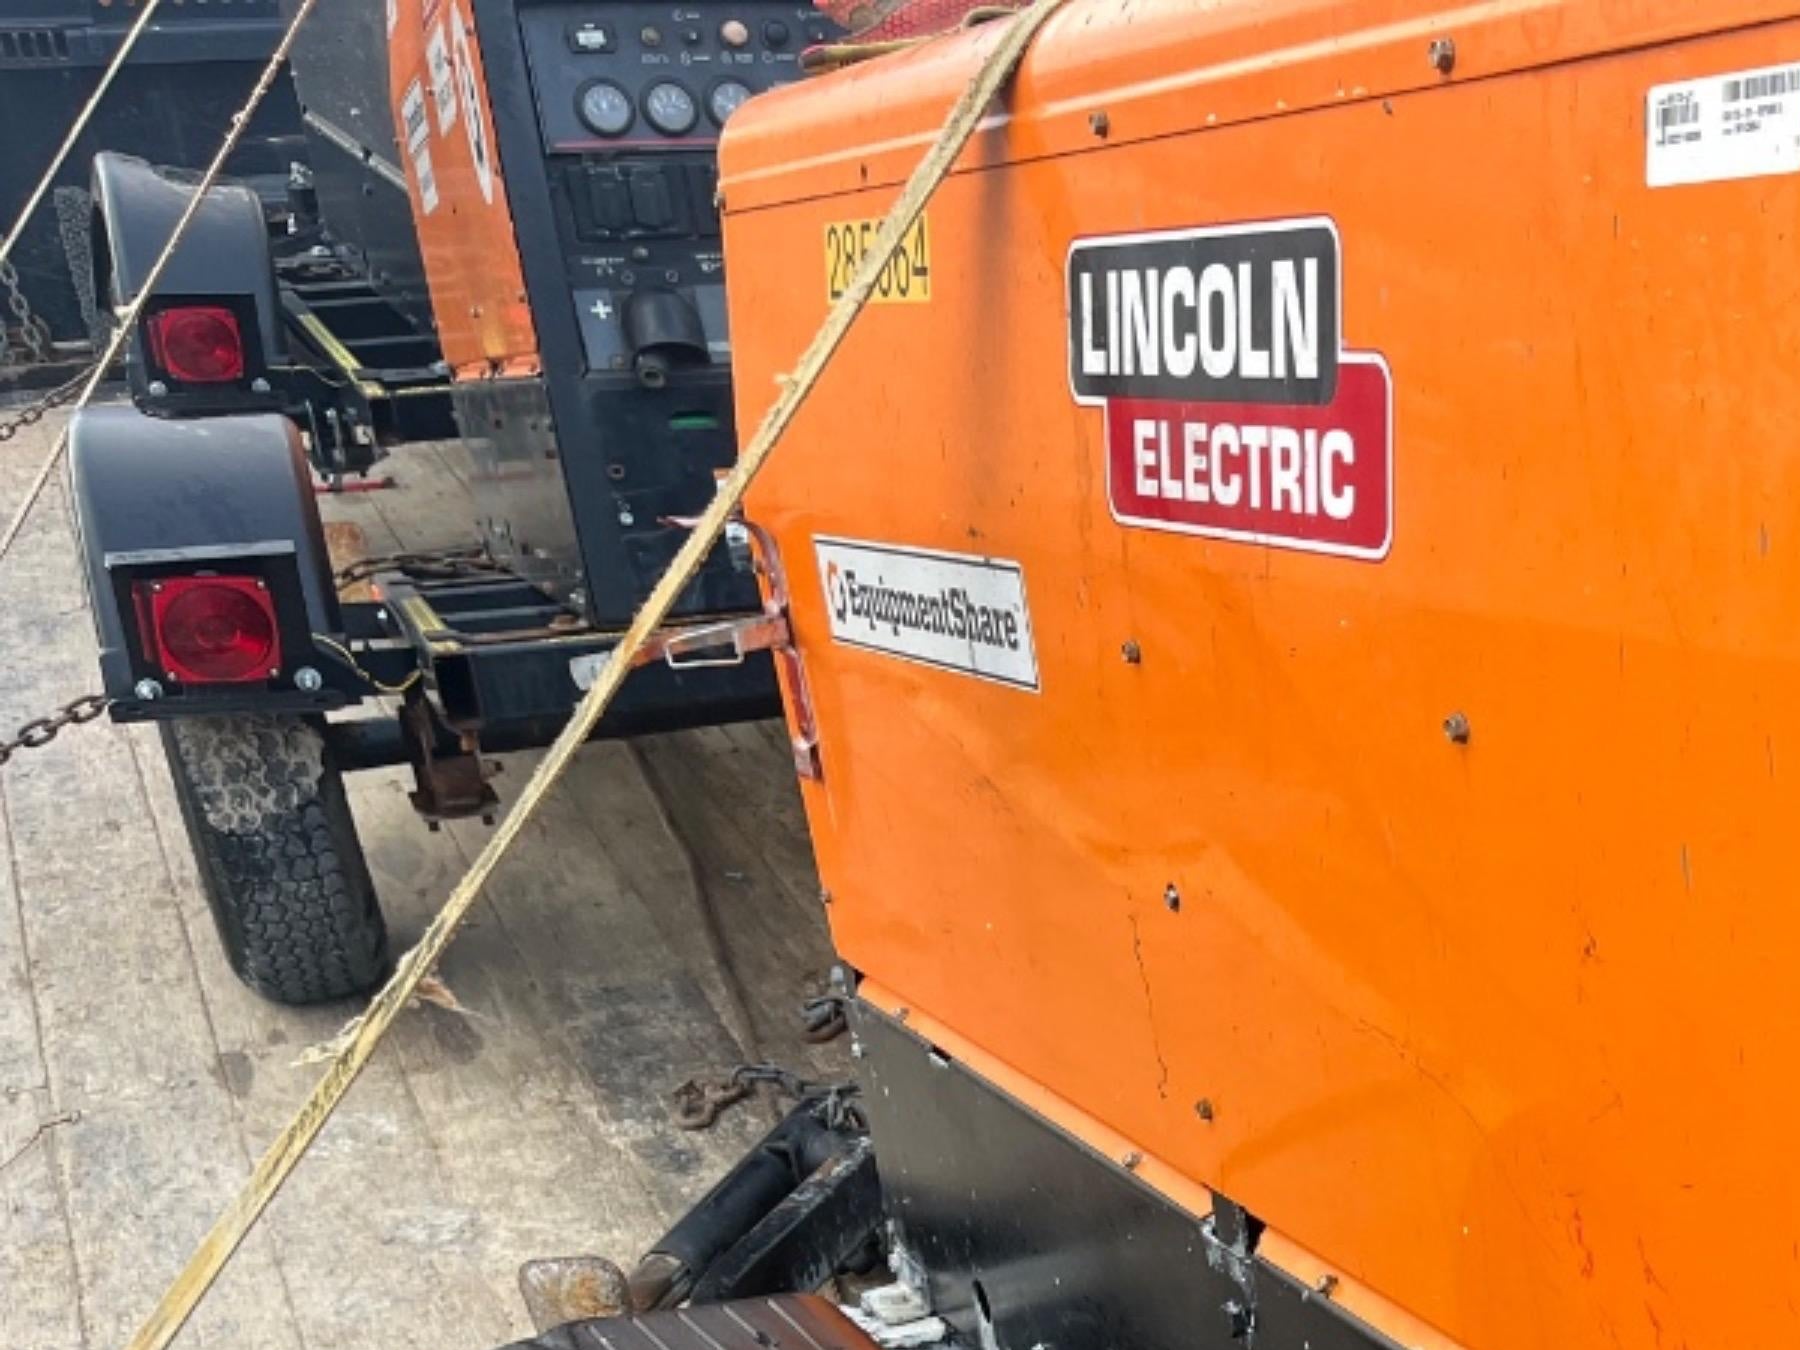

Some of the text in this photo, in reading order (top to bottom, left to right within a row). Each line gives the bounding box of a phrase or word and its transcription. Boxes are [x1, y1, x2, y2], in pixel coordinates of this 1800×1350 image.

[1080, 256, 1319, 380] LINCOLN
[1133, 418, 1355, 520] ELECTRIC
[843, 568, 1019, 651] EquipmentShare
